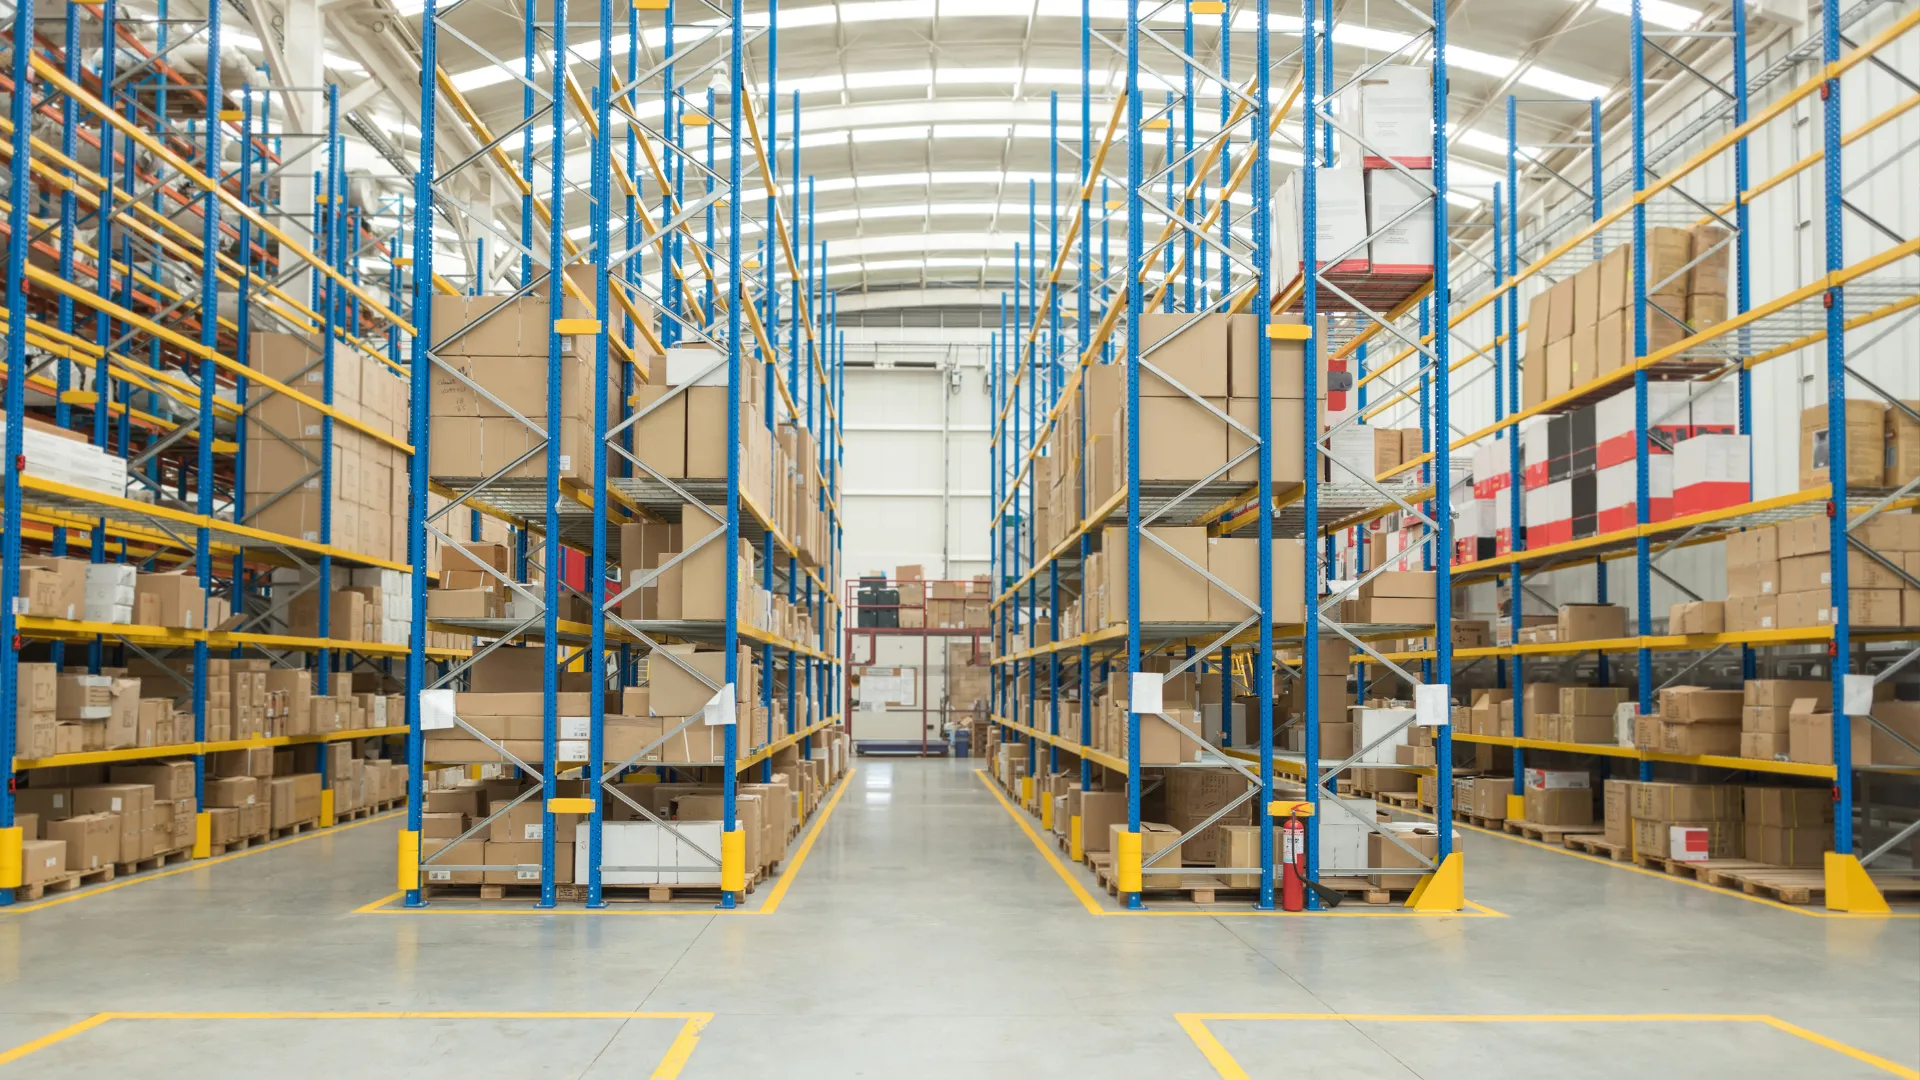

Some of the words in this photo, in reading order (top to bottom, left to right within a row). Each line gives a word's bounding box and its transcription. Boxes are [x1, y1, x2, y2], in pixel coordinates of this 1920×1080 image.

[1826, 501, 1834, 516] 3
[13, 635, 21, 649] 2
[1828, 641, 1836, 655] 2
[8, 777, 17, 792] 1
[1831, 786, 1839, 800] 1
